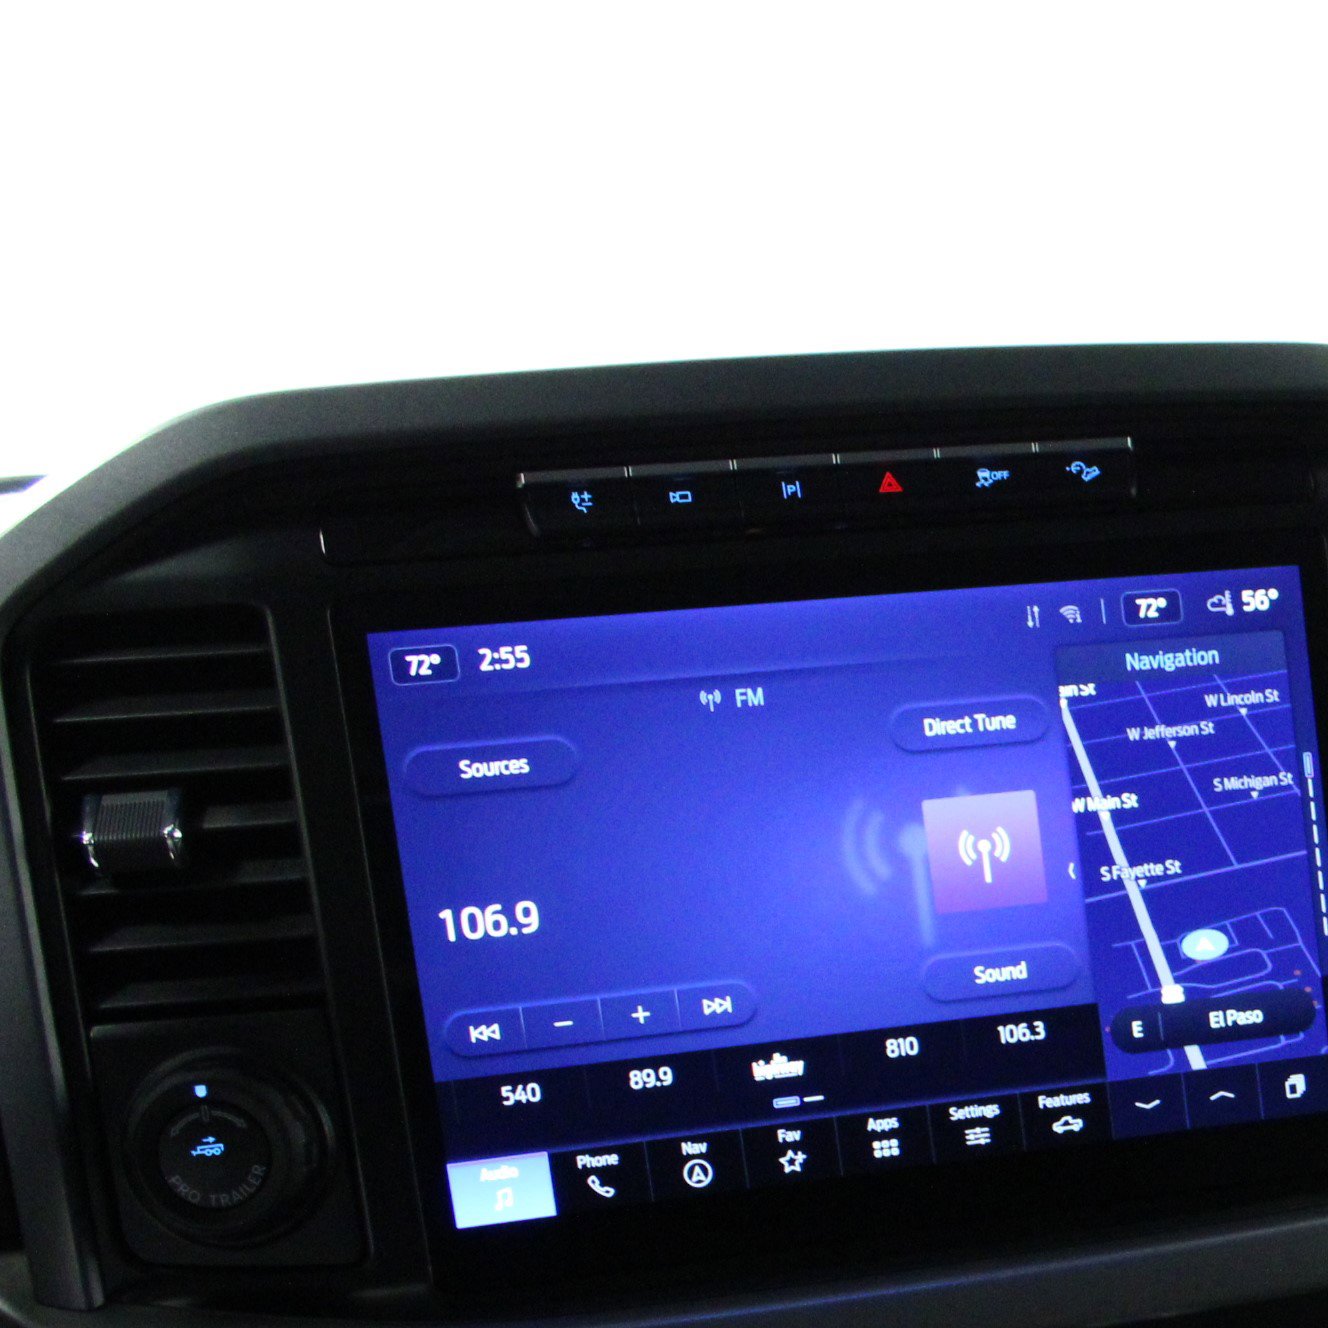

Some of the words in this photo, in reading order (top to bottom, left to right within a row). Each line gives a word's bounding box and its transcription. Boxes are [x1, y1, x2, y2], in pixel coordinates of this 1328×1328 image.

[991, 469, 1010, 481] OFF
[1135, 597, 1168, 619] 72°
[1241, 588, 1280, 612] 56°
[405, 653, 441, 676] 72°
[478, 645, 531, 672] 2:55
[1125, 648, 1219, 672] Navigation
[735, 687, 765, 708] FM
[1204, 693, 1219, 708] W
[1219, 690, 1265, 707] Lincoln
[1265, 689, 1280, 702] St
[923, 715, 971, 738] Direct
[975, 712, 1017, 733] Tune
[1126, 726, 1142, 742] W
[1143, 723, 1197, 740] Jefferson
[1199, 720, 1215, 735] St
[458, 756, 530, 780] Sources
[1213, 777, 1223, 792] S
[1223, 774, 1278, 792] Michigan
[1279, 771, 1294, 786] St
[1087, 795, 1121, 812] Main
[1121, 792, 1139, 809] St
[1100, 866, 1111, 882] S
[1111, 863, 1164, 880] Fayette
[1165, 859, 1182, 875] St
[438, 900, 540, 942] 106.9
[973, 961, 1028, 984] Sound
[1209, 1011, 1227, 1029] El
[1229, 1007, 1264, 1027] Paso
[997, 1021, 1046, 1045] 106.3
[1131, 1021, 1143, 1038] E
[885, 1036, 919, 1058] 810
[629, 1067, 673, 1090] 89.9
[501, 1083, 541, 1106] 540
[1037, 1090, 1091, 1109] Features
[949, 1102, 1000, 1121] Settings
[777, 1128, 802, 1143] Fav
[867, 1116, 899, 1133] Apps
[681, 1140, 708, 1156] Nav
[576, 1152, 619, 1169] Phone
